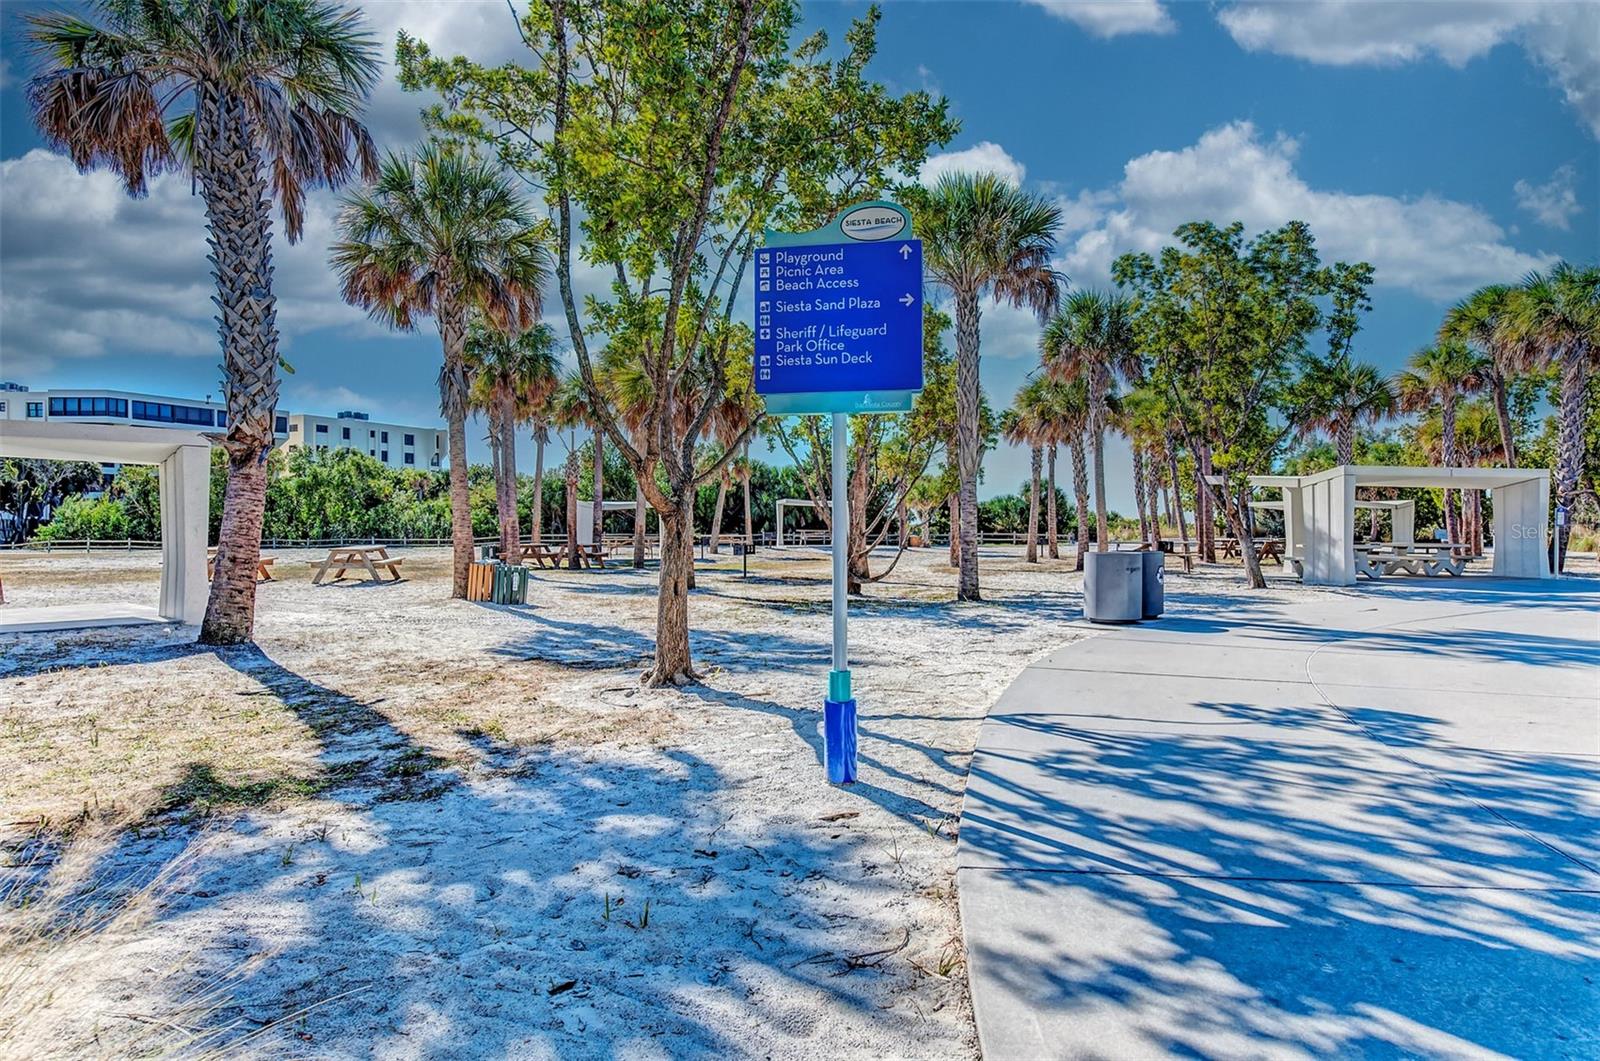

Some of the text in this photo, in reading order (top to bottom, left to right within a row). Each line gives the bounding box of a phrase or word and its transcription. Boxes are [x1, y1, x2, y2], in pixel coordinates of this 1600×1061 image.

[845, 216, 902, 227] SIESTA BEACH
[776, 248, 844, 266] Playground
[776, 264, 844, 277] Picnic Area
[776, 277, 859, 291] Beach Access
[776, 297, 881, 313] Siesta Sand Plaza
[776, 323, 887, 339] Sheriff / Lifeguard
[776, 339, 845, 353] Park Office
[776, 351, 873, 366] Siesta Sun Deck
